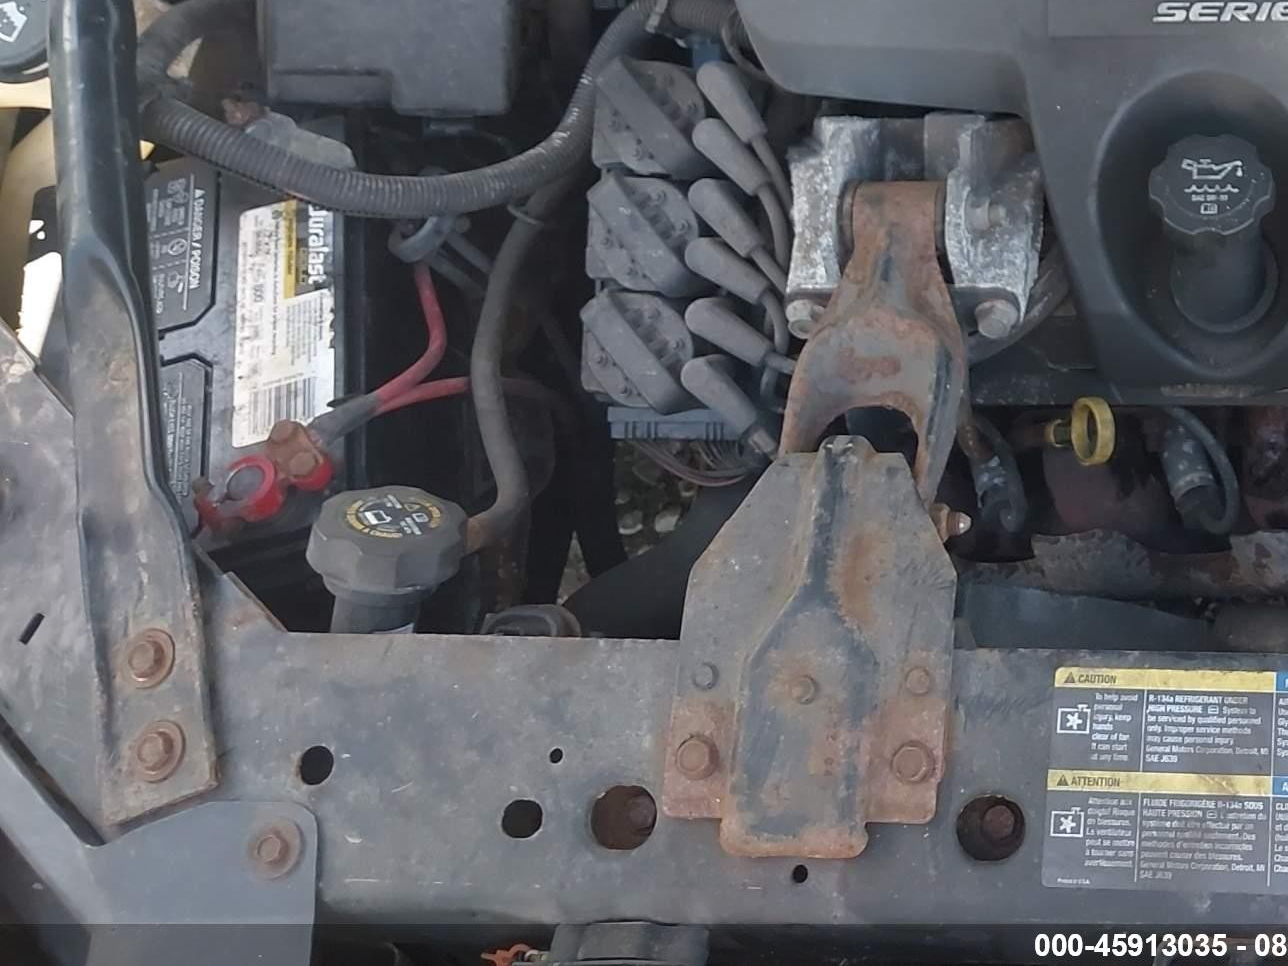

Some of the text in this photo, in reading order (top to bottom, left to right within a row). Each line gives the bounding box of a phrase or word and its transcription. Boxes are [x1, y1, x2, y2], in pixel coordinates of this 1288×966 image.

[192, 198, 205, 242] DANGER
[189, 249, 202, 290] POISON
[1078, 674, 1117, 684] CAUTION
[1175, 695, 1223, 704] REFRIGERANT
[1167, 705, 1202, 713] PRESSURE
[1071, 777, 1120, 786] ATTENTION
[1244, 801, 1264, 810] SOUS
